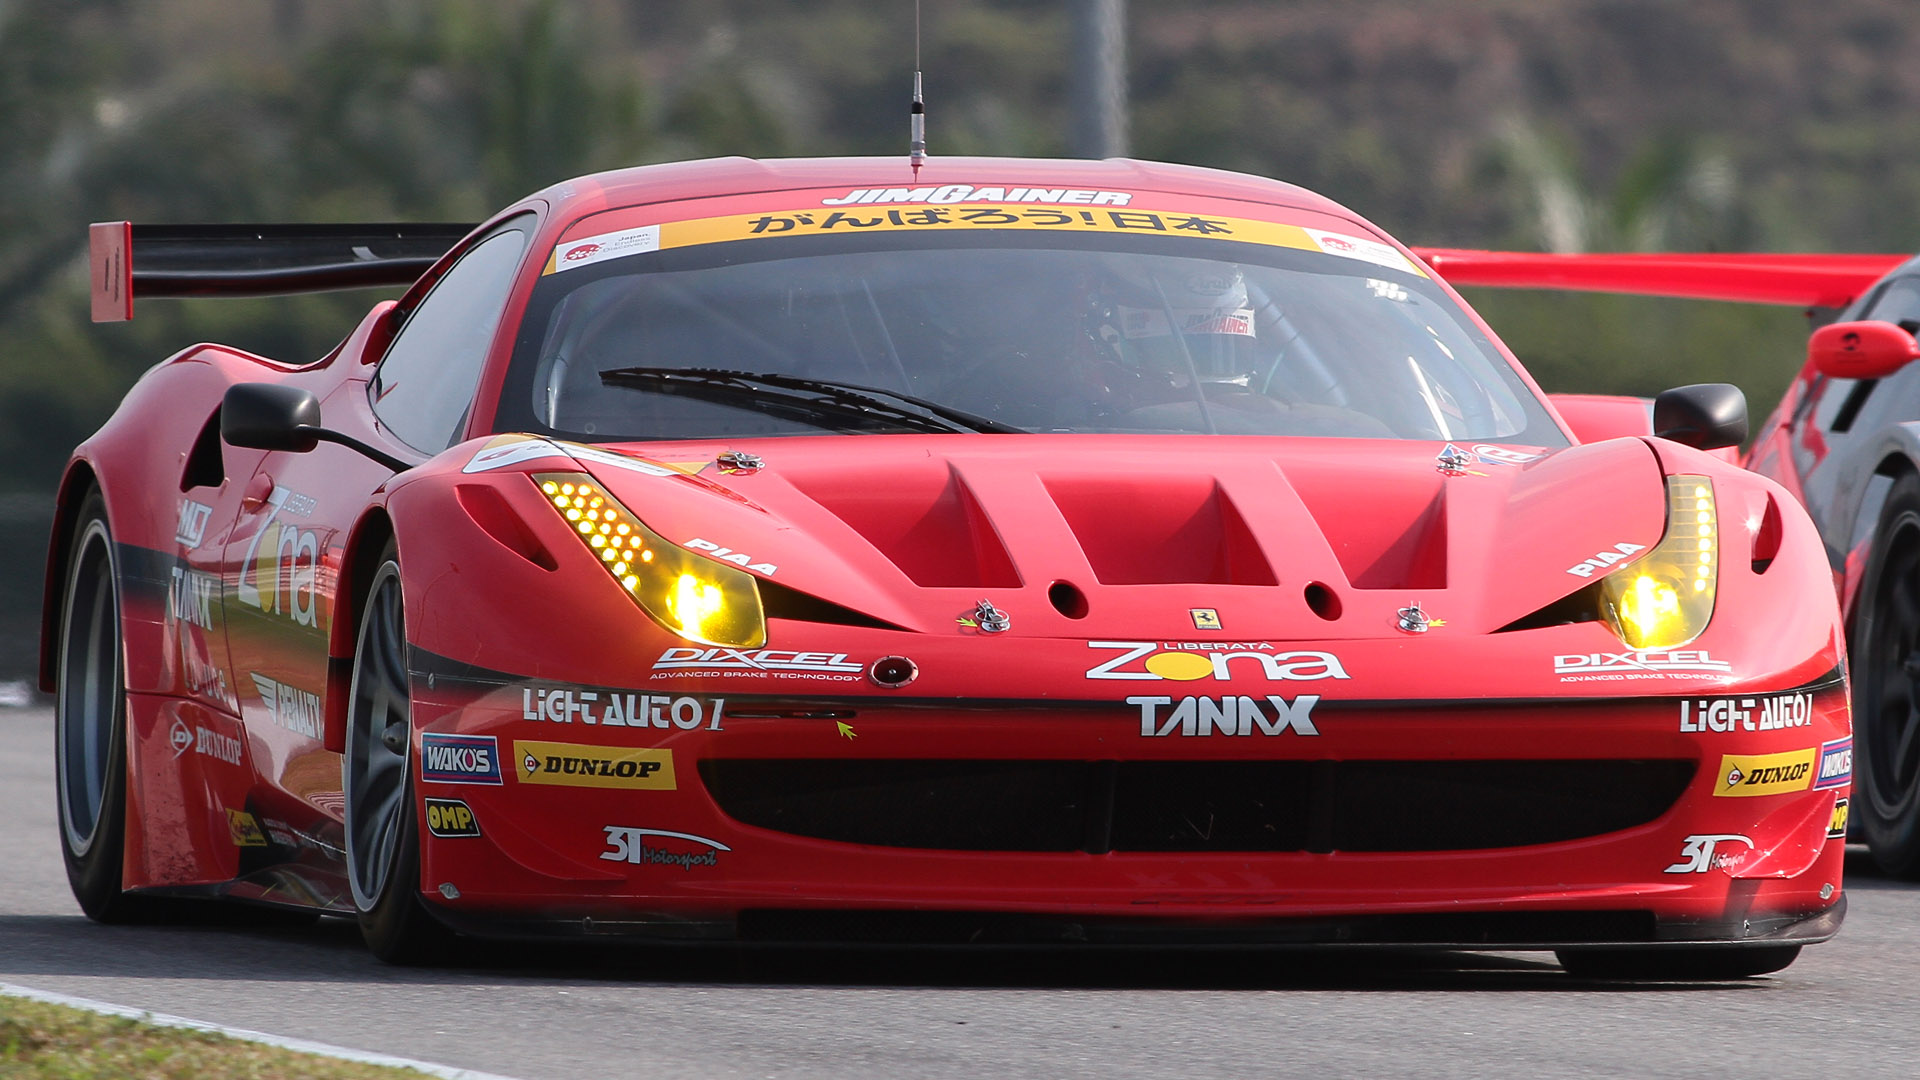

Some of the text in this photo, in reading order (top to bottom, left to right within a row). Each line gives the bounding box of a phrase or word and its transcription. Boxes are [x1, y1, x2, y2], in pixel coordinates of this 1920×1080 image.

[823, 184, 1133, 206] JIMGAINER
[747, 208, 1234, 236] がんばろう!日本
[683, 538, 778, 576] PIAA
[1566, 542, 1646, 578] PIAA
[653, 648, 863, 672] DIXCEL
[1554, 650, 1731, 672] DIXCEL
[650, 671, 863, 682] ADVANCED BRAKE TECHNOLOGY
[1560, 674, 1625, 683] ADVANCED
[1626, 672, 1665, 681] BRAKE
[195, 726, 241, 767] DUNLOP
[543, 756, 661, 778] DUNLOP
[1744, 762, 1810, 785] DUNLOP
[428, 805, 472, 829] OMP
[1830, 805, 1848, 830] MP
[642, 846, 717, 871] Motorsport
